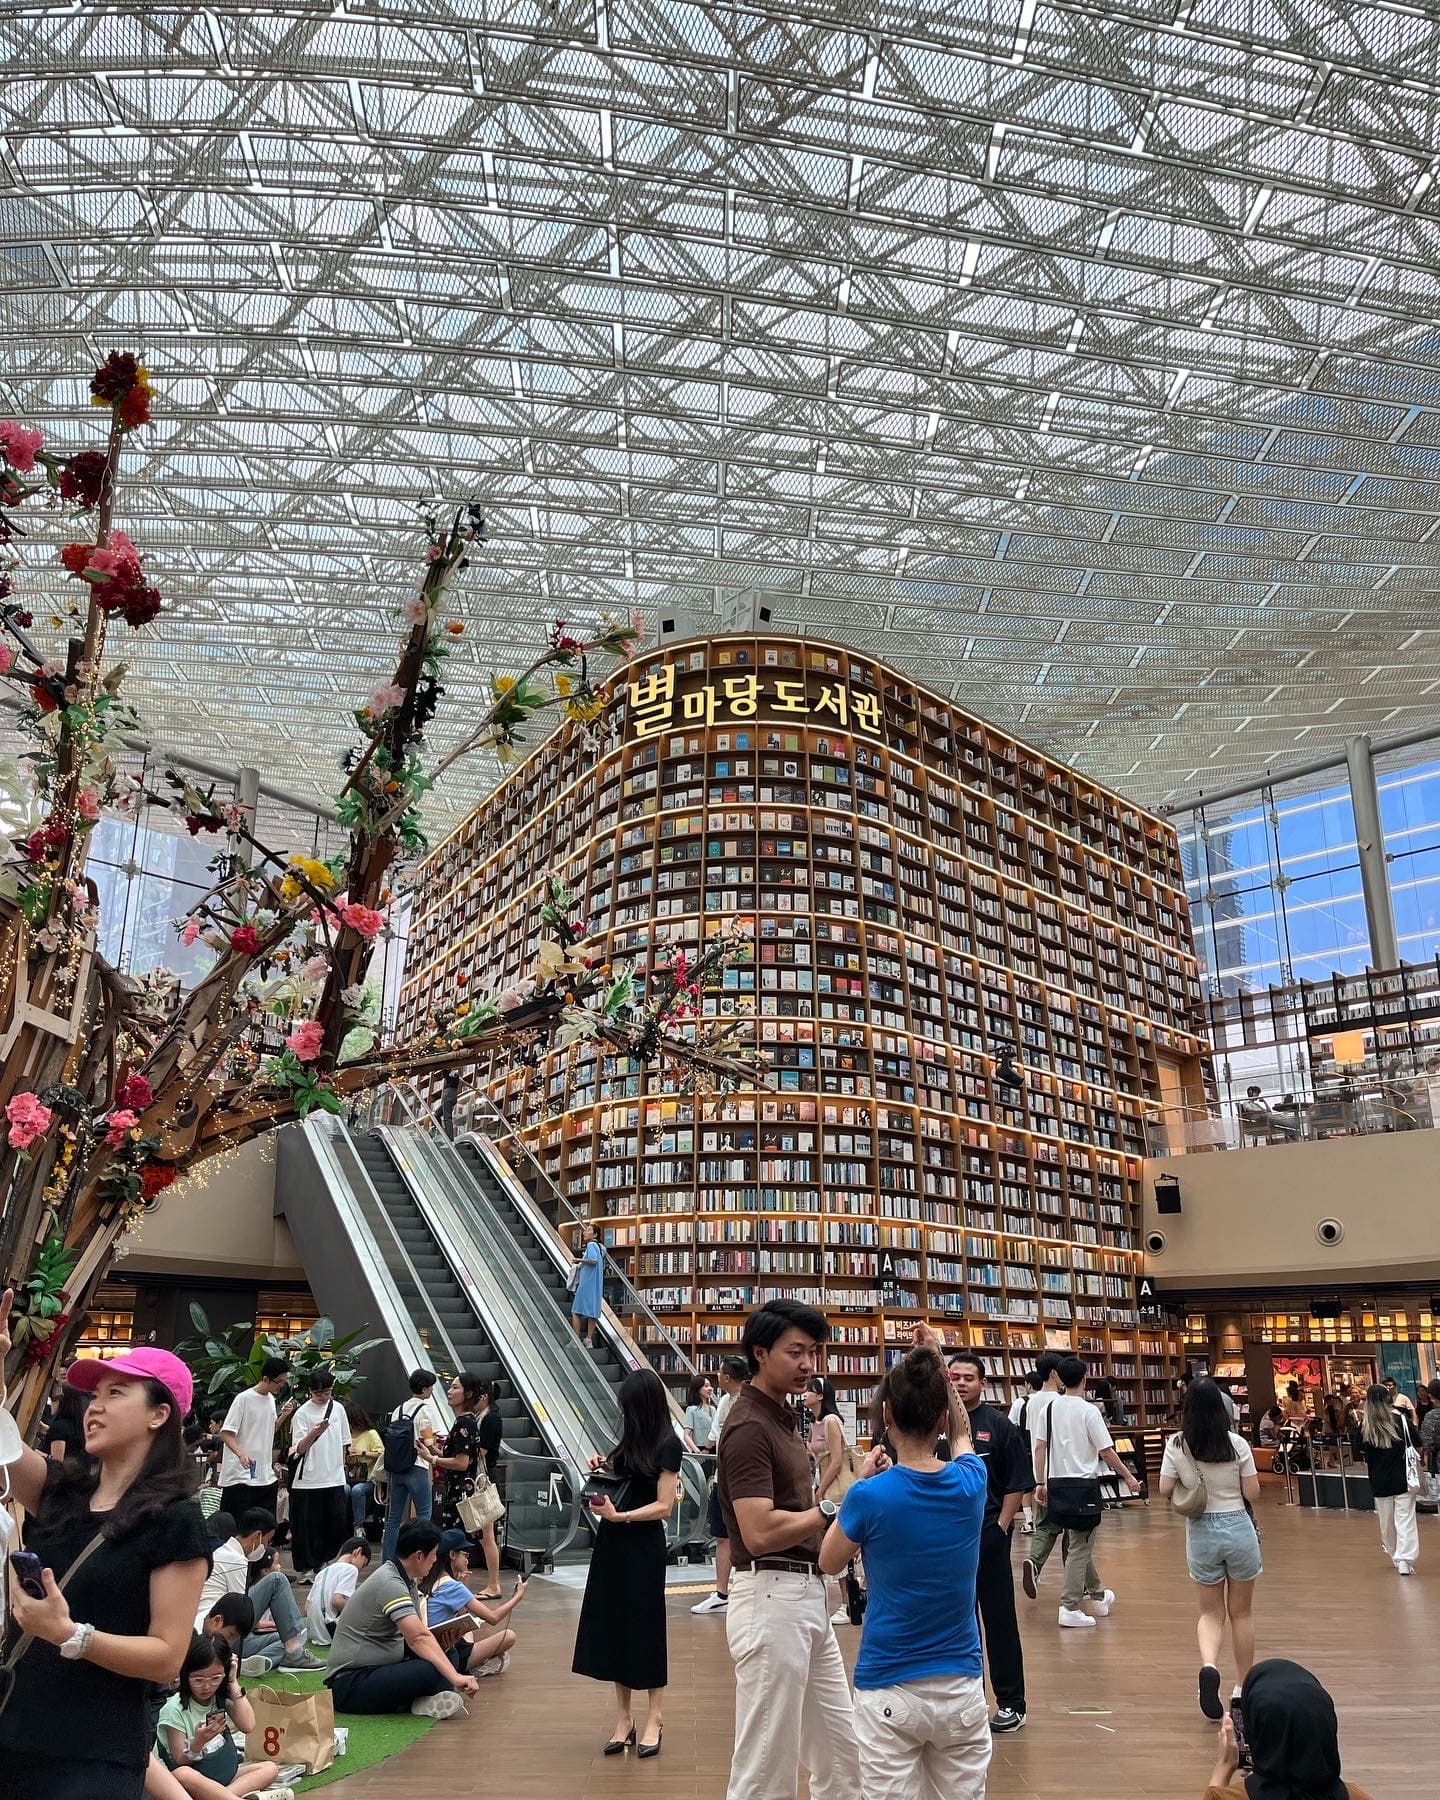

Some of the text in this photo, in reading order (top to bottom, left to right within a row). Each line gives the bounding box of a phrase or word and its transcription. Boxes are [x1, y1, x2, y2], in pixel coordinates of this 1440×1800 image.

[628, 663, 883, 737] 별마당 도서관
[882, 1253, 893, 1272] A
[1140, 1280, 1152, 1296] A
